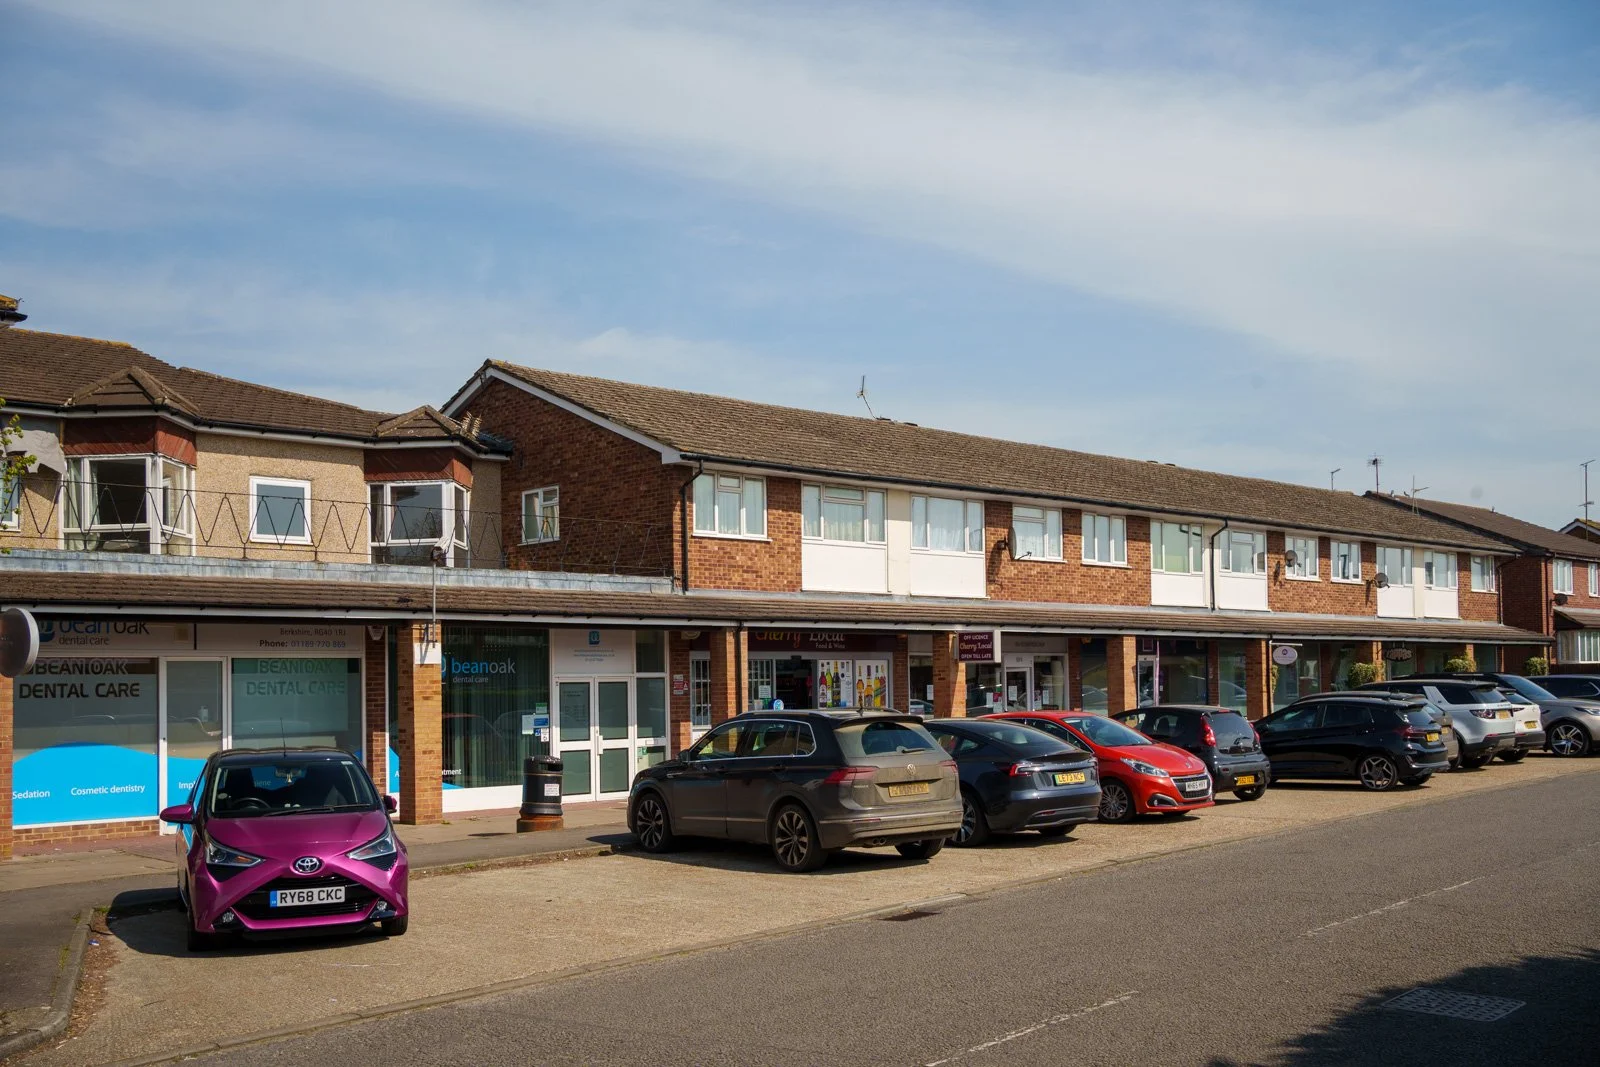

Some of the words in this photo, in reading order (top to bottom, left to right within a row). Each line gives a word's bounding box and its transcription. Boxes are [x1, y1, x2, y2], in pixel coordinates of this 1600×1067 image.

[59, 636, 88, 645] dental
[259, 639, 288, 648] Phone:
[960, 642, 977, 652] Cherry
[453, 675, 474, 683] dental
[19, 683, 89, 699] DENTAL
[95, 682, 140, 697] CARE
[247, 681, 303, 695] DENTAL
[309, 681, 345, 694] CARE
[12, 790, 50, 800] Sedation
[71, 786, 109, 796] Cosmetic
[110, 784, 145, 795] dentistry
[279, 890, 314, 904] RY68
[317, 888, 342, 901] CKC
